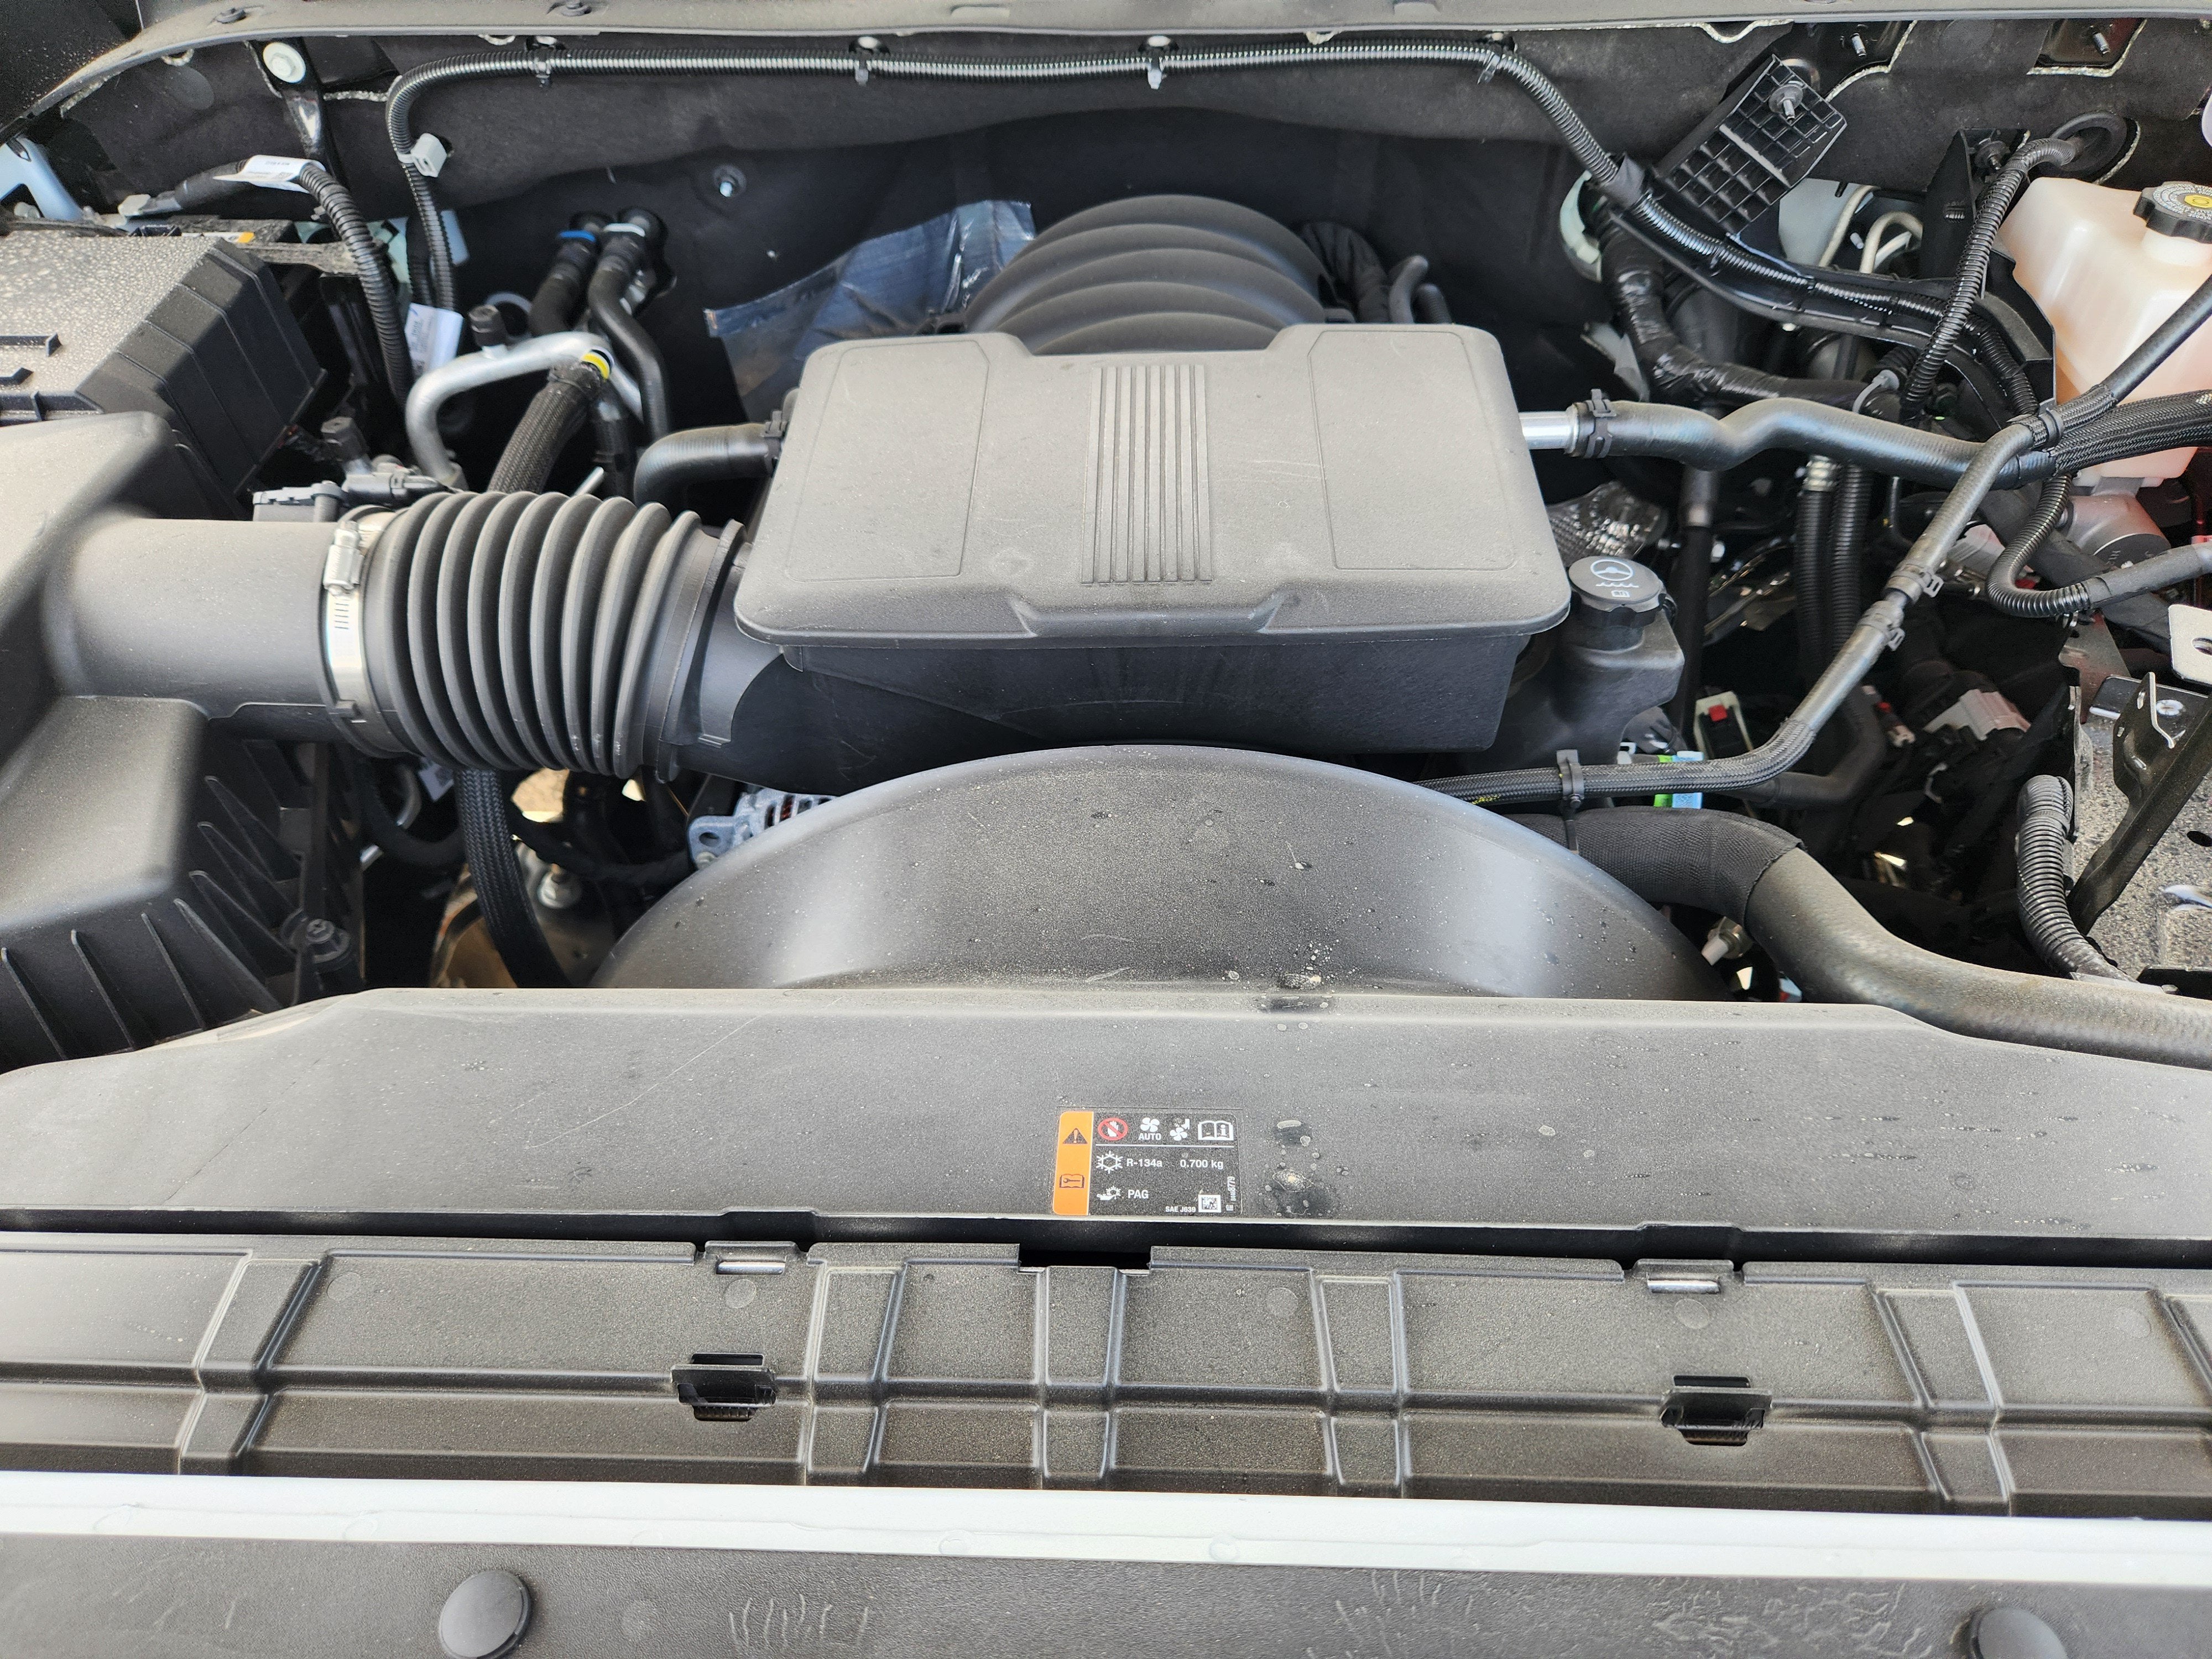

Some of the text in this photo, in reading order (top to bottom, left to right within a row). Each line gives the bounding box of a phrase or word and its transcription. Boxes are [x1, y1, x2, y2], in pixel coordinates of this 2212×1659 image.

[1126, 1158, 1223, 1170] R-134a 0.700 kg
[1128, 1190, 1149, 1199] PAG
